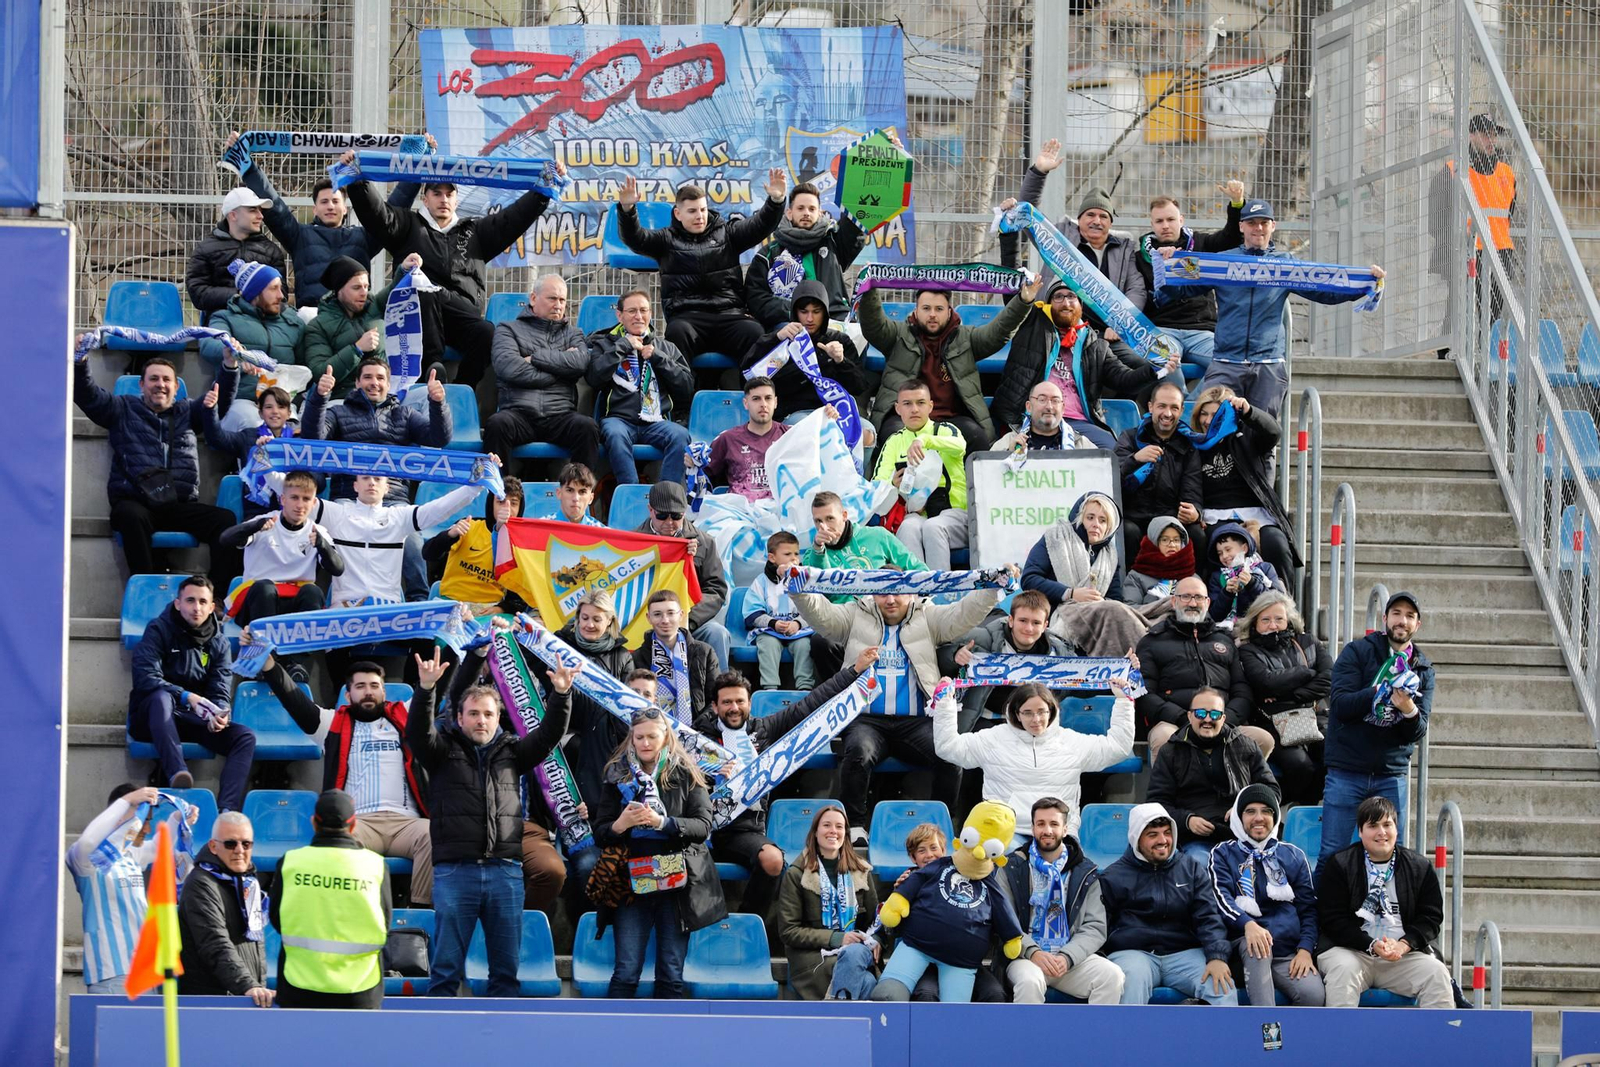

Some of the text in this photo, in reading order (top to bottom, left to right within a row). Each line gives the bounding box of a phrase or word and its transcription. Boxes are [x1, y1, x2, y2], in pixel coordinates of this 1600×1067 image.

[437, 38, 725, 156] LOS 300
[389, 153, 509, 180] MALAGA
[553, 138, 640, 167] 1000
[851, 156, 905, 170] PRESIDENTE
[857, 145, 900, 160] PENALTI
[916, 267, 965, 282] somos
[1225, 262, 1350, 287] MALAGA
[1051, 245, 1084, 281] KMS
[1080, 274, 1109, 308] UNA
[1107, 302, 1157, 349] PASIÓN
[281, 443, 455, 478] MALAGA
[1003, 469, 1076, 489] PENALTI
[265, 615, 382, 645] MALAGA
[494, 635, 532, 707] nosotros
[826, 692, 858, 732] LOS
[294, 873, 373, 892] SEGURETA
